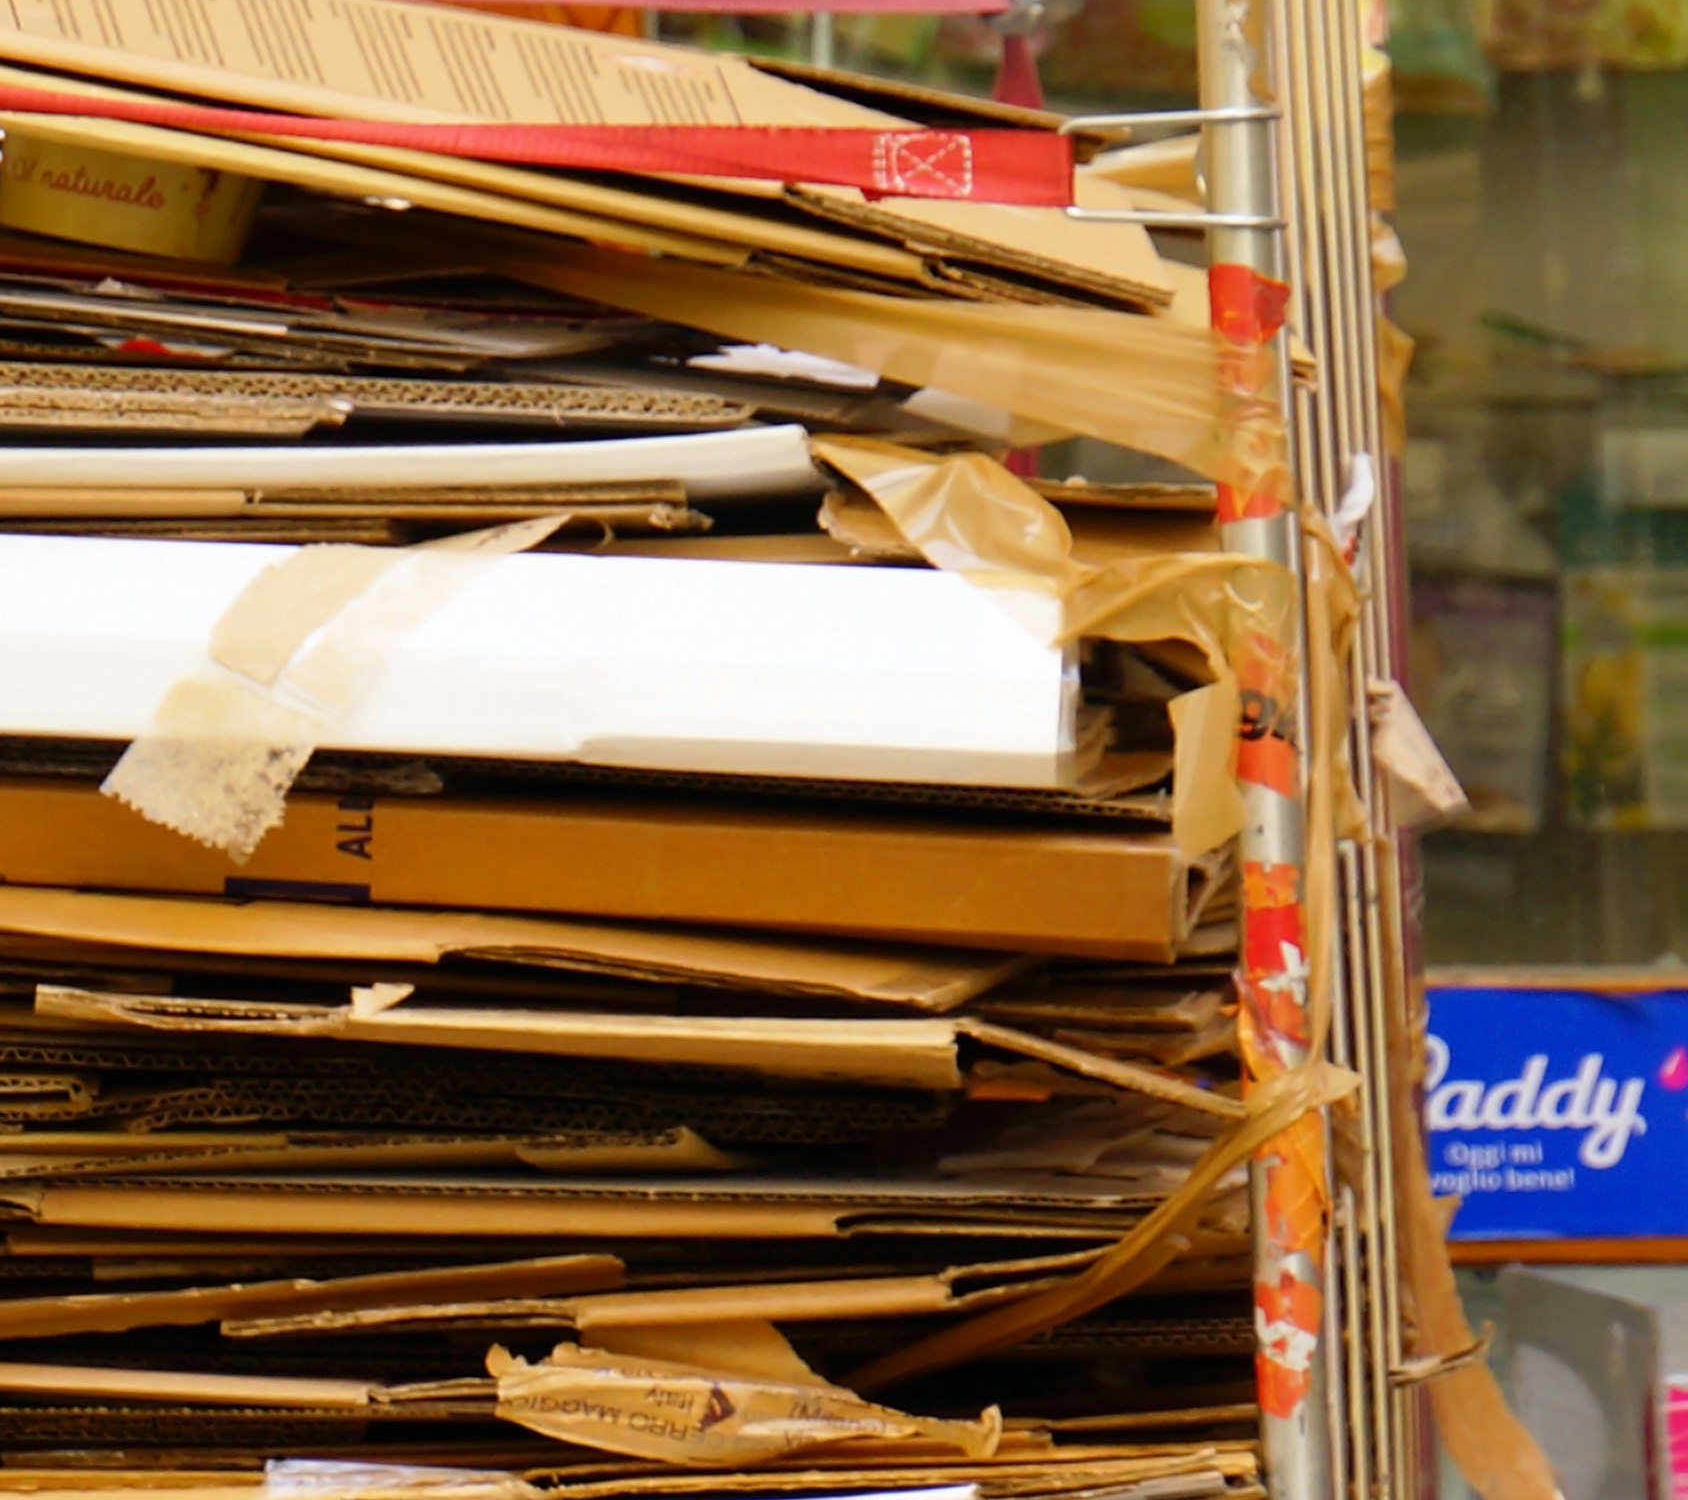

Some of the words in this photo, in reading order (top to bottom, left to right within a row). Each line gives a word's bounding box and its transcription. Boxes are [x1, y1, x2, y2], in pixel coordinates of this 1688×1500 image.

[40, 164, 168, 211] naturale
[1443, 1141, 1507, 1168] Oggi
[1509, 1140, 1544, 1166] mi
[1431, 1168, 1503, 1195] voglio
[1506, 1167, 1576, 1192] bene!
